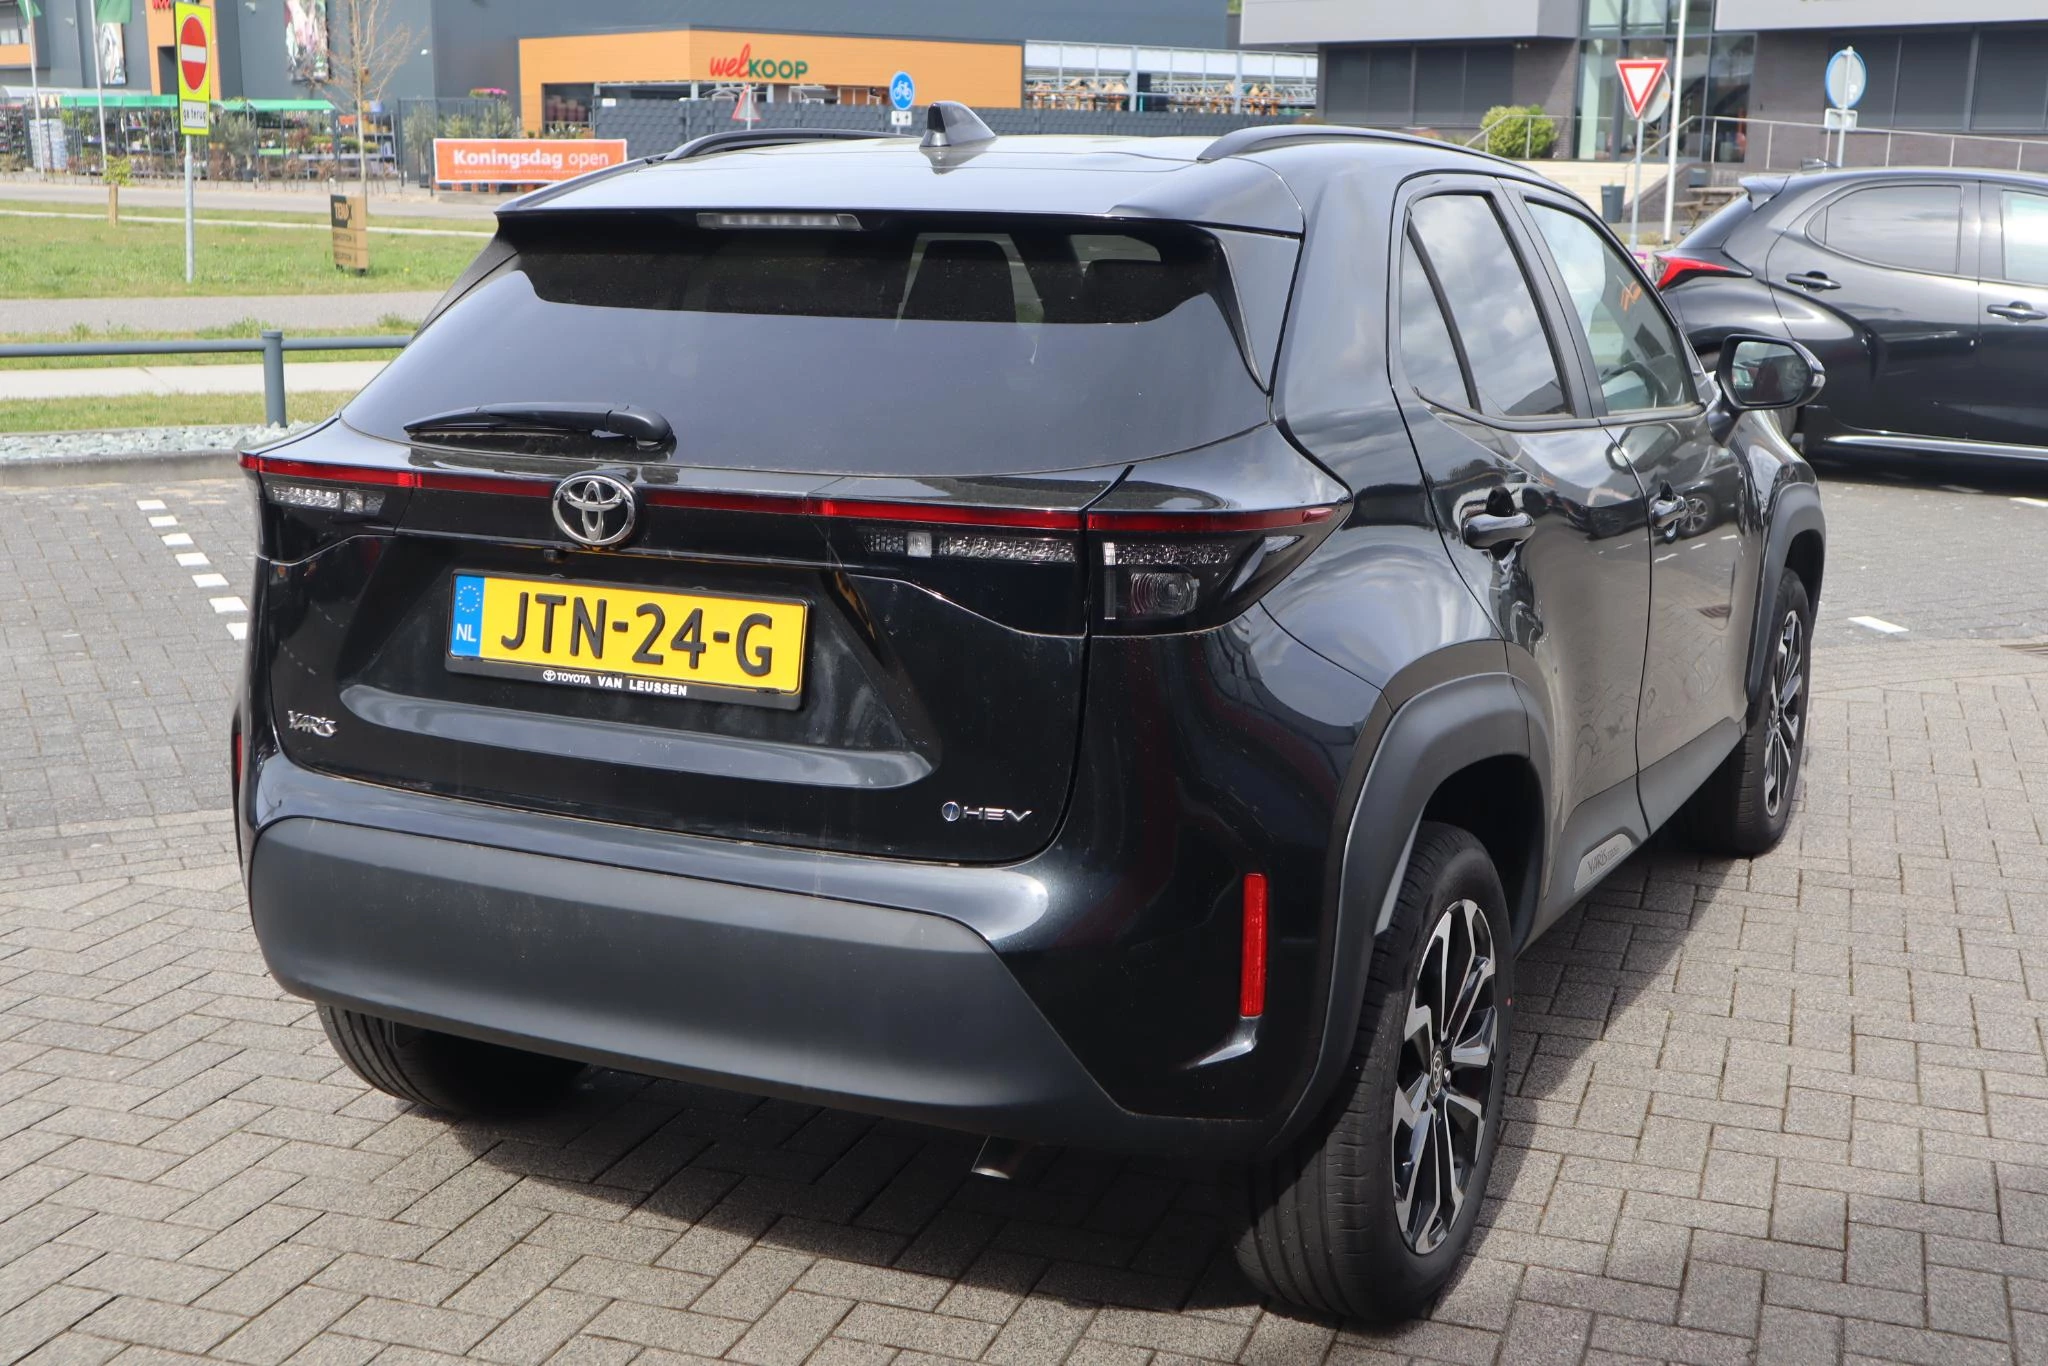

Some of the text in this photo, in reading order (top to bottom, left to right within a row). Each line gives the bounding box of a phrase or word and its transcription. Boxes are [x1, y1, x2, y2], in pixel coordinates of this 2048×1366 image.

[453, 149, 609, 168] Koningsdag open
[455, 622, 478, 643] NL
[501, 592, 773, 677] JTN-24-G
[556, 672, 688, 696] TOYOTA VAN LEUSSEN
